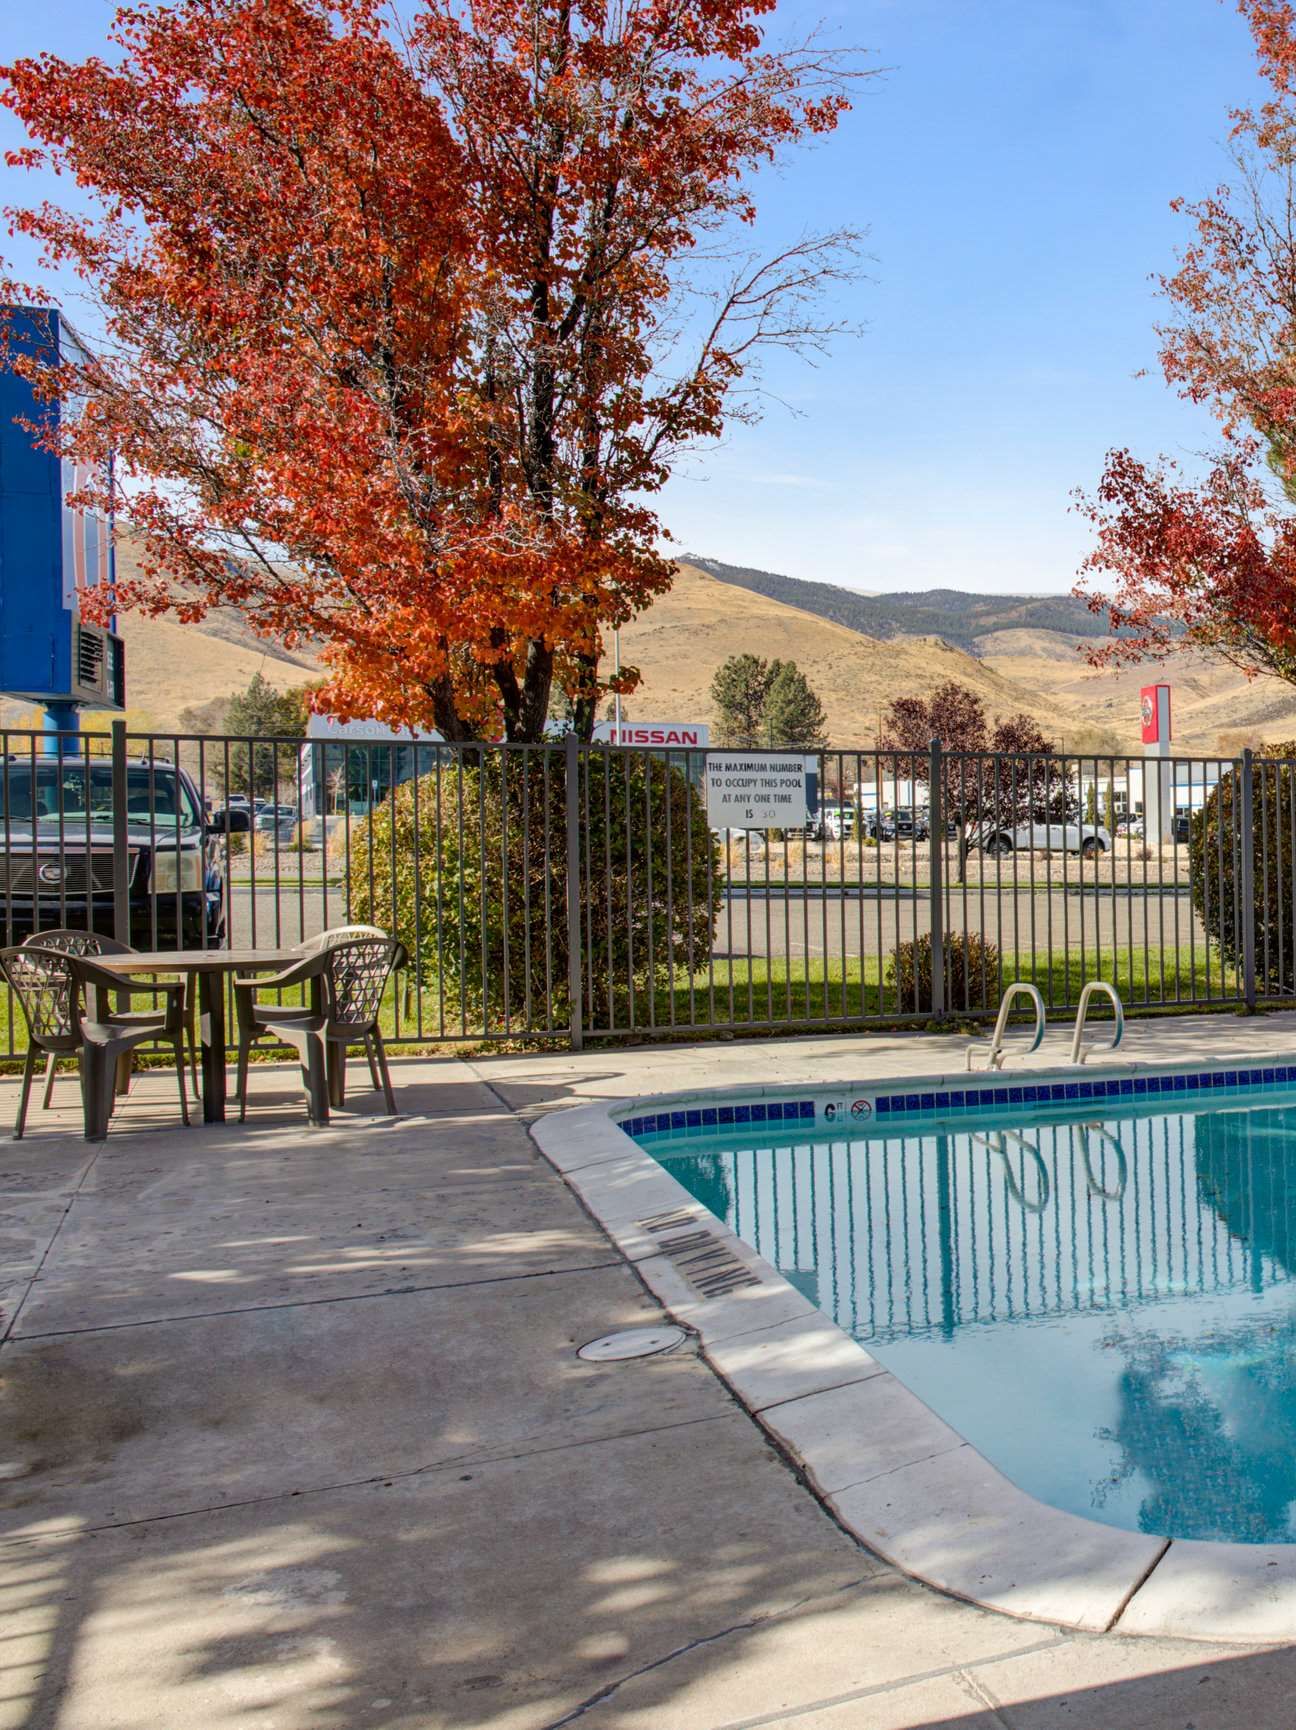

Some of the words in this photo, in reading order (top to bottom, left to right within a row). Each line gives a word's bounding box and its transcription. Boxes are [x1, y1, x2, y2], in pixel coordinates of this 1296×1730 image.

[609, 729, 697, 745] NISSAN
[708, 762, 722, 772] THE
[725, 763, 767, 772] MAXIMUM
[769, 763, 802, 773] NUMBER
[711, 778, 722, 787] TO
[725, 778, 757, 787] OCCUPY
[760, 779, 778, 788] THIS
[780, 779, 802, 788] POOL
[722, 794, 732, 803] AT
[733, 794, 751, 803] ANY
[754, 794, 771, 803] ONE
[773, 795, 792, 803] TIME
[745, 809, 754, 818] IS
